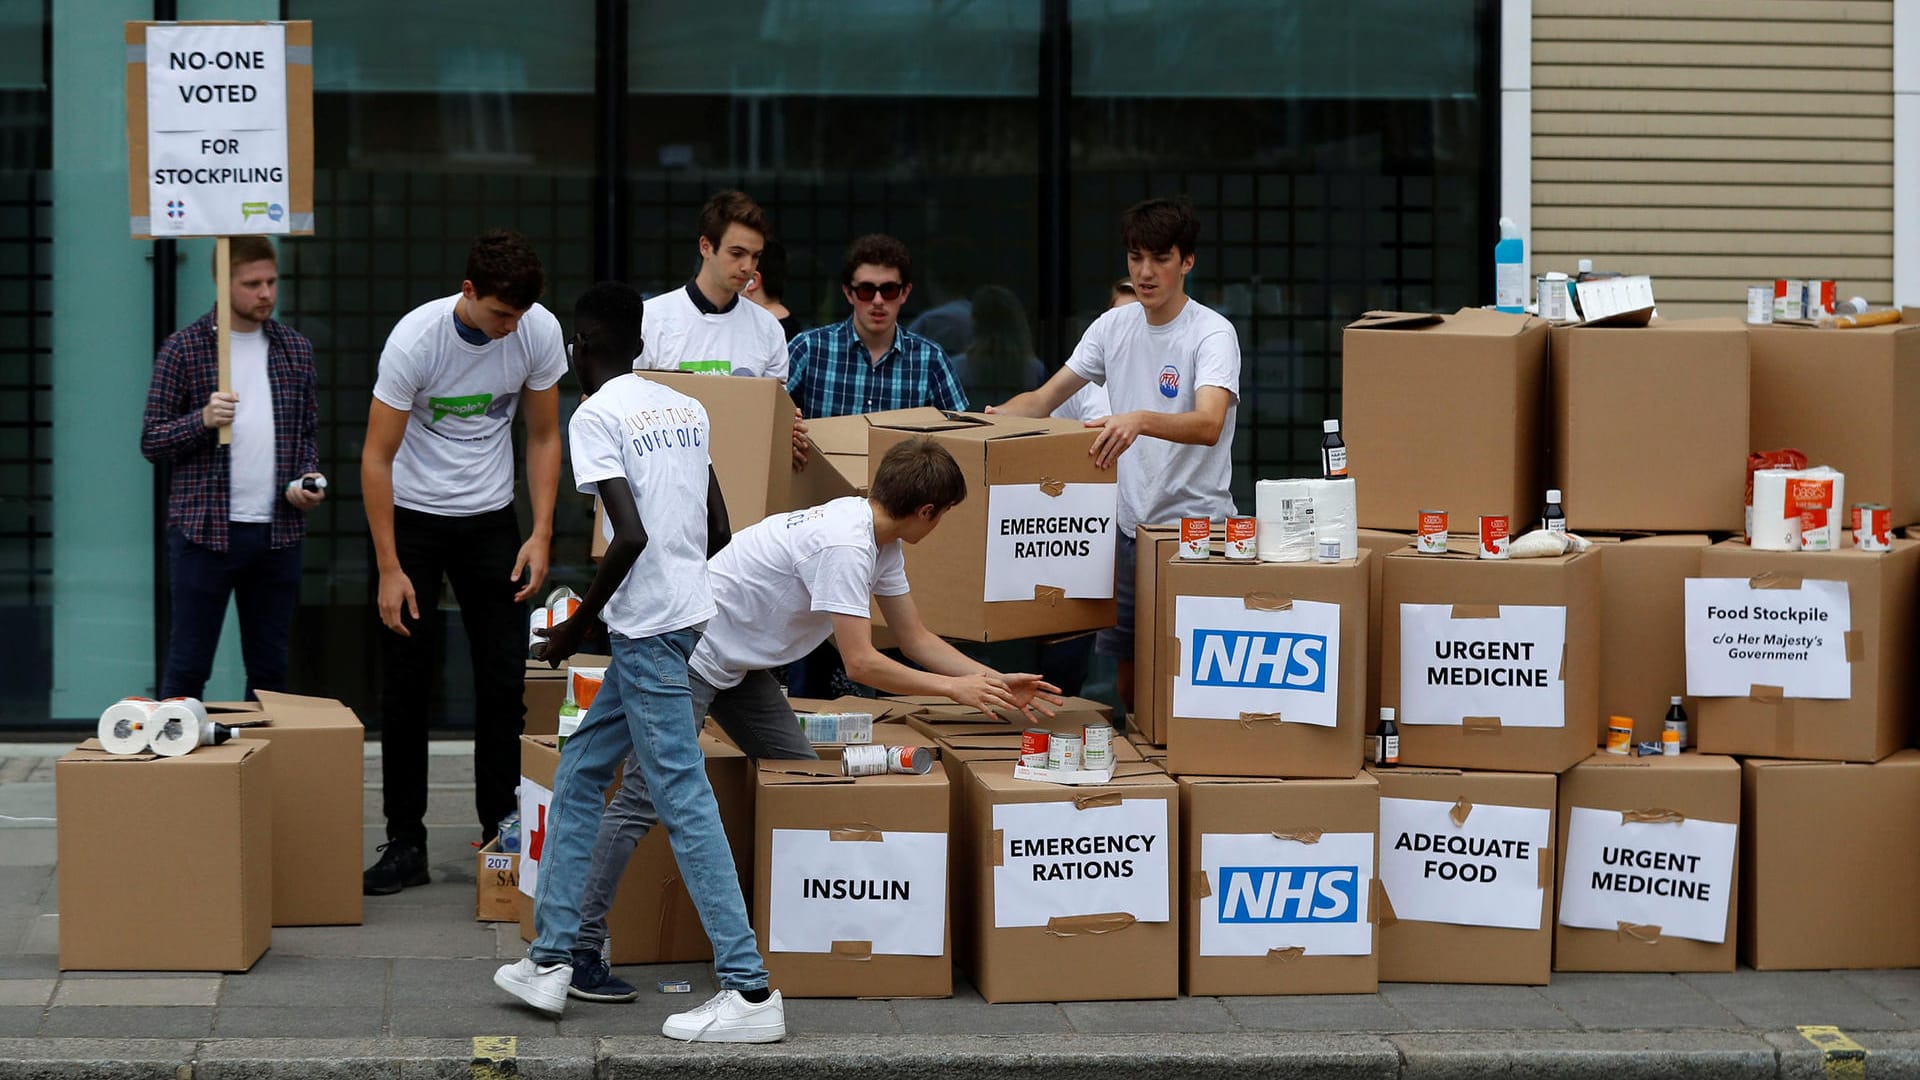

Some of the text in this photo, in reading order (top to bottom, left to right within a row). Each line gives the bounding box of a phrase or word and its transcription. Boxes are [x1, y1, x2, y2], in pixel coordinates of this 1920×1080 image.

[170, 51, 265, 70] NO-ONE
[179, 85, 257, 103] VOTED
[201, 139, 239, 154] FOR
[155, 167, 283, 184] STOCKPILING
[1000, 517, 1110, 535] EMERGENCY
[1015, 540, 1090, 558] RATIONS
[1707, 606, 1828, 624] Food Stockpile
[1435, 640, 1534, 660] URGENT
[1712, 633, 1823, 648] c/o Her Majesty's
[1195, 634, 1323, 687] NHS
[1728, 648, 1808, 660] Government
[1427, 667, 1548, 687] MEDICINE
[1010, 835, 1156, 857] EMERGENCY
[1394, 832, 1530, 859] ADEQUATE
[487, 858, 508, 869] 207
[1602, 847, 1701, 873] URGENT
[1032, 860, 1134, 881] RATIONS
[1424, 860, 1497, 883] FOOD
[803, 879, 910, 900] INSULIN
[1222, 870, 1353, 919] NHS
[1591, 871, 1711, 901] MEDICINE
